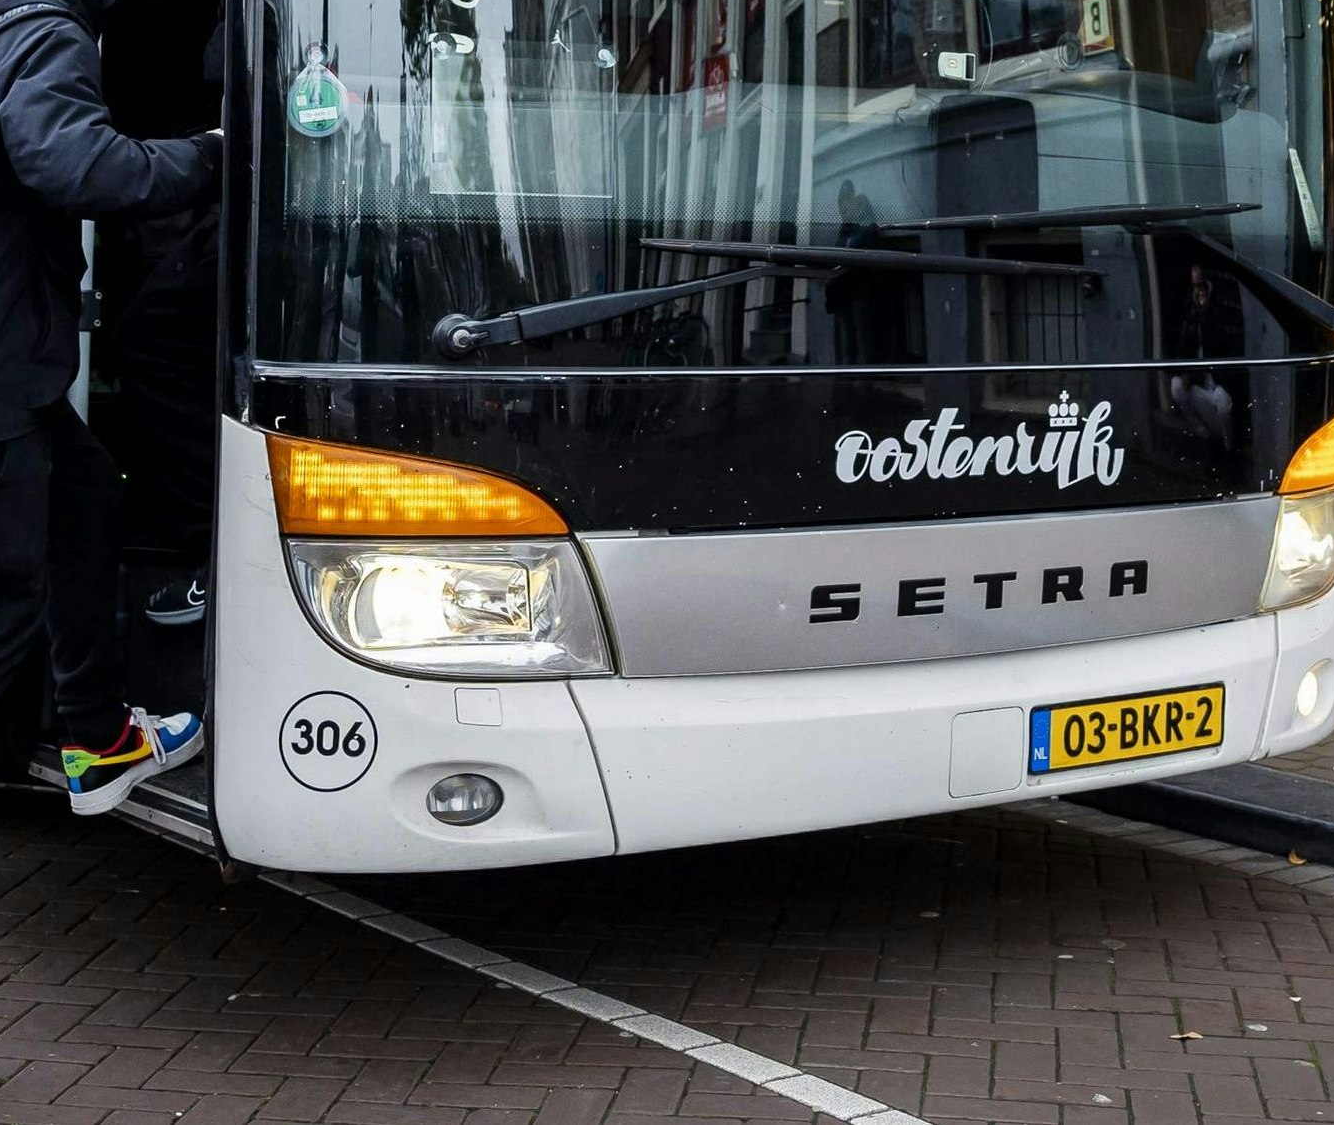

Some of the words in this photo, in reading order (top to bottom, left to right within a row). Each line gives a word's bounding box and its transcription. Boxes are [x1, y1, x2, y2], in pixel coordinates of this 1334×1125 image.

[809, 559, 1149, 623] SETRA
[291, 718, 366, 757] 306
[1034, 747, 1048, 761] NL
[1064, 696, 1213, 757] 03-BKR-2
